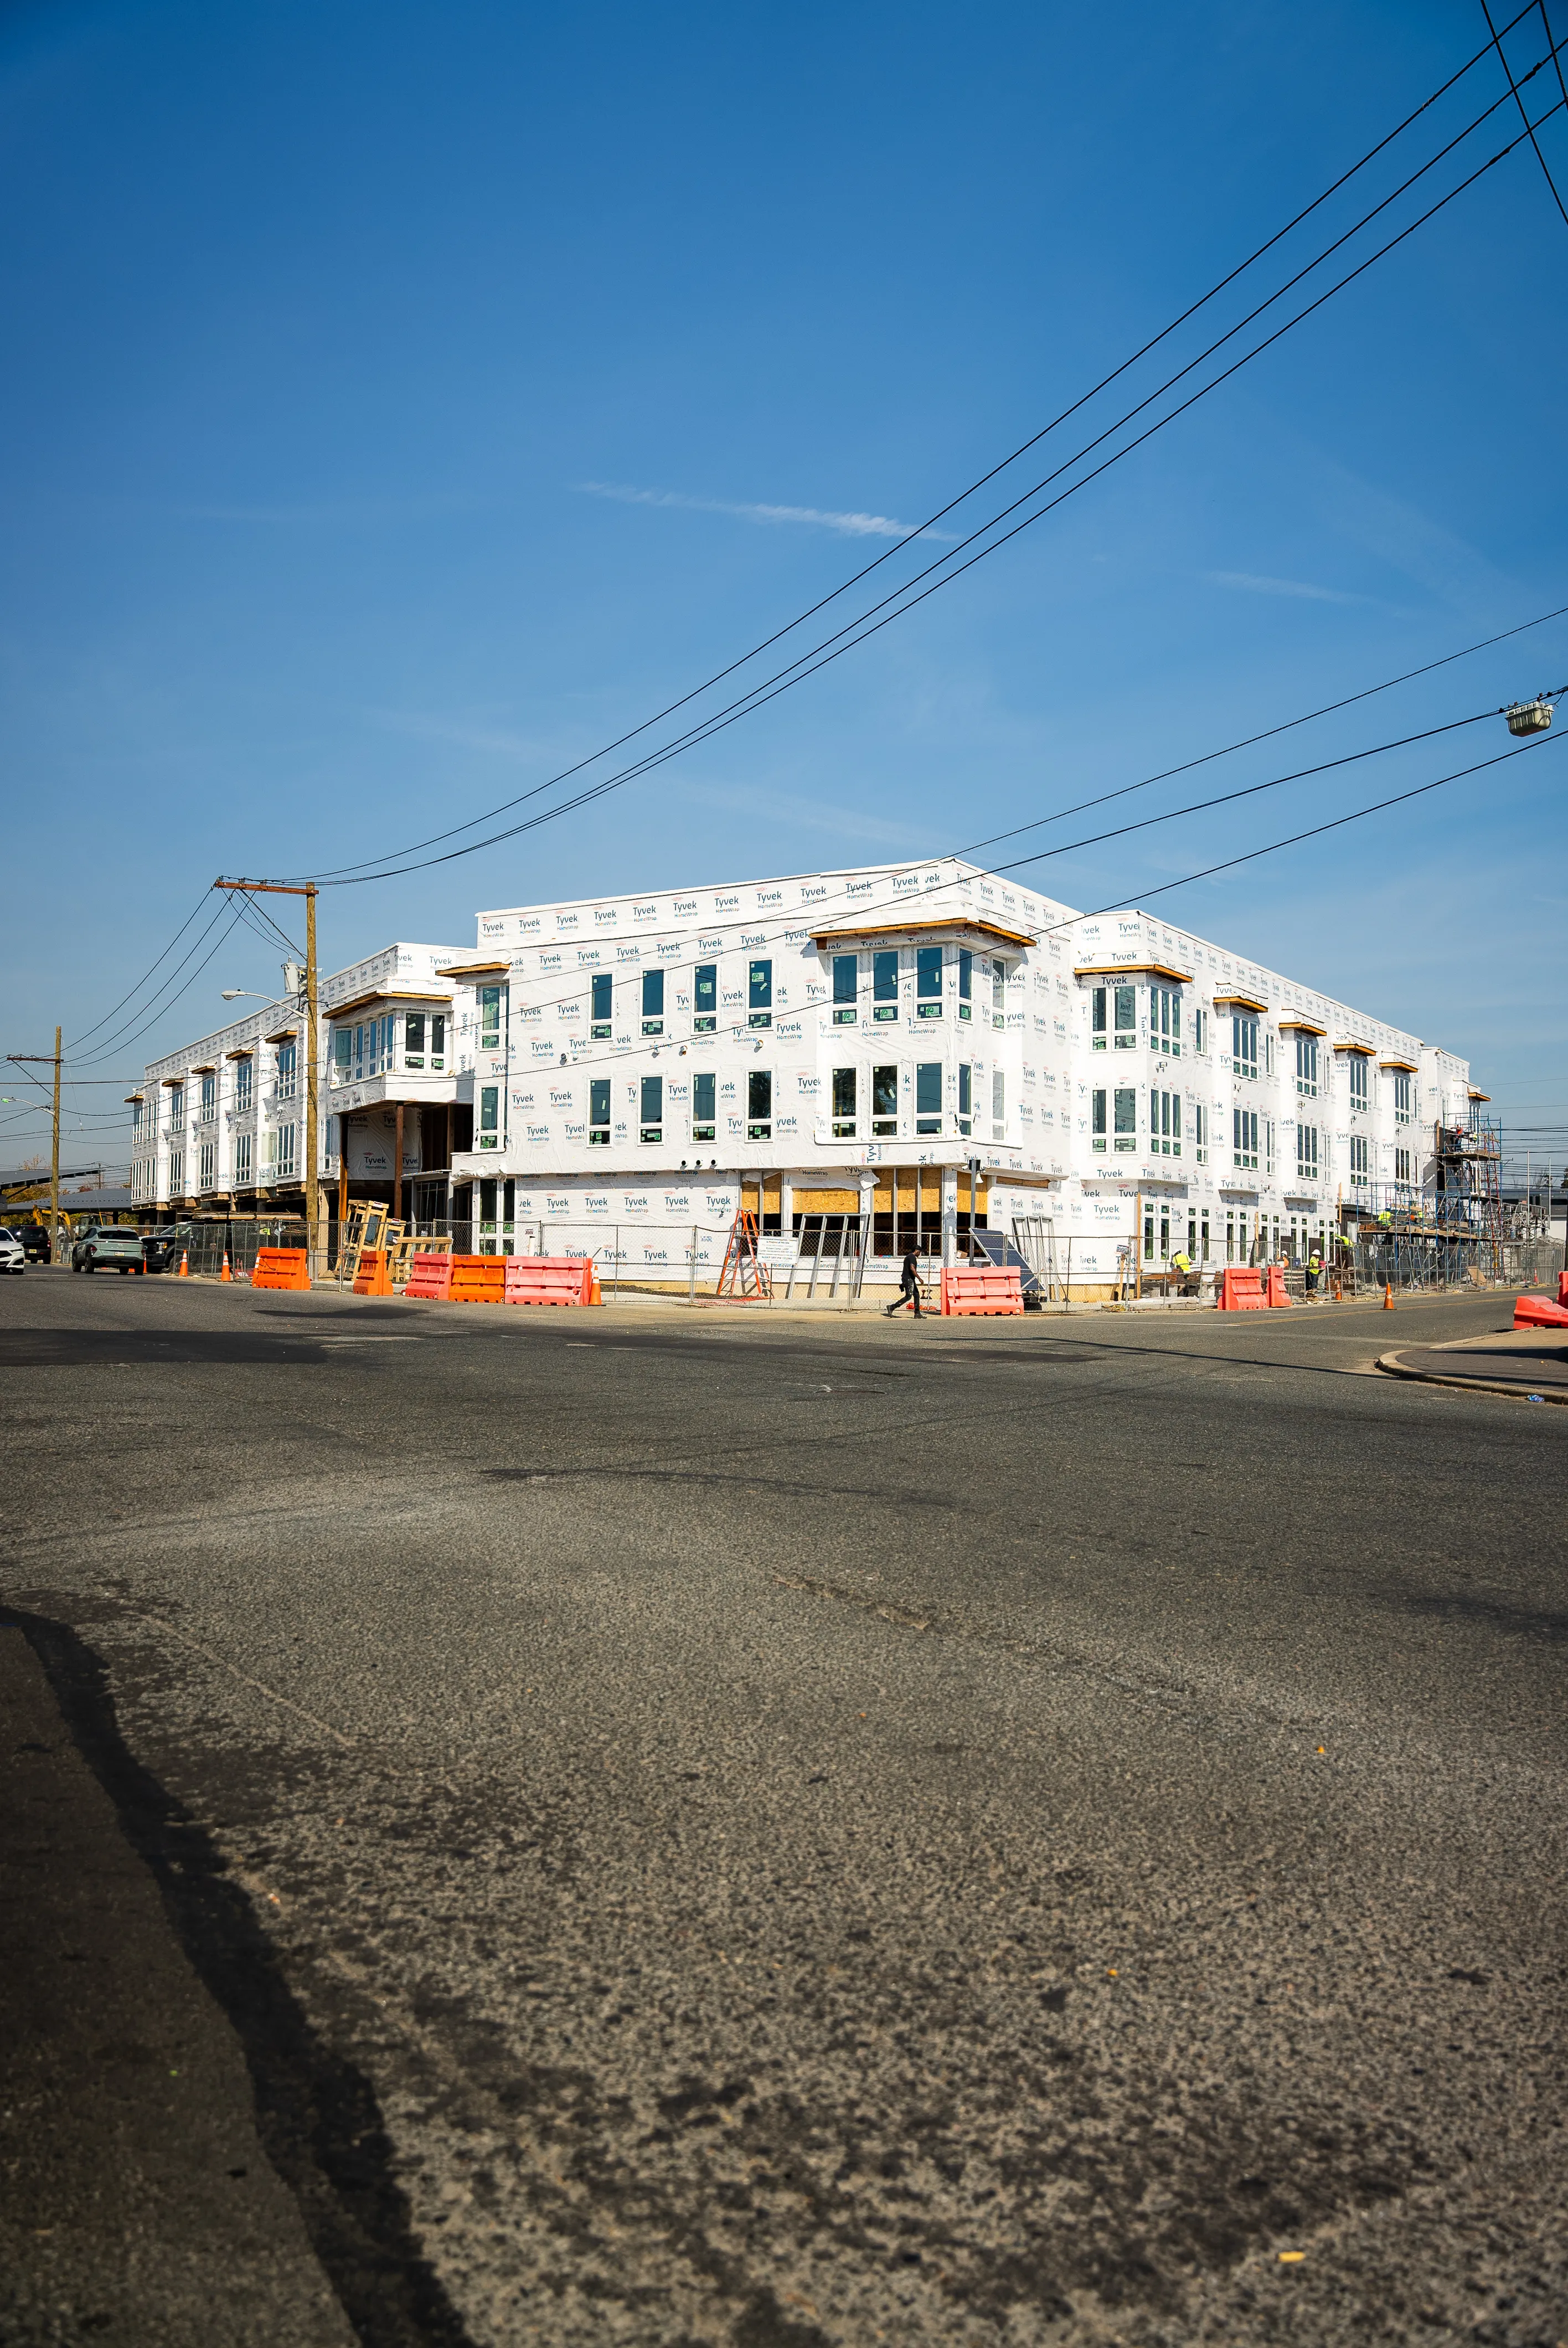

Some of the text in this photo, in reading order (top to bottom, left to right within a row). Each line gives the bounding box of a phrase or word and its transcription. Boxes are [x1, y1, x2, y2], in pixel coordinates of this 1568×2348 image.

[892, 876, 918, 888] Tyvek
[957, 873, 971, 886] Tyvek
[801, 887, 826, 898] Tyvek
[845, 881, 871, 893] Tyvek
[980, 883, 993, 895] Tyvek
[715, 896, 739, 908] Tyvek
[757, 891, 781, 903] Tyvek
[1002, 892, 1015, 904] Tyvek
[633, 905, 656, 916] Tyvek
[673, 901, 697, 912] Tyvek
[1023, 900, 1035, 913] Tyvek
[556, 914, 577, 925] Tyvek
[594, 910, 616, 921] Tyvek
[1043, 909, 1055, 920] Tyvek
[483, 922, 503, 933] Tyvek
[519, 918, 540, 929] Tyvek
[784, 930, 809, 941] Tyvek
[1147, 926, 1157, 937] Tyvek
[698, 939, 722, 950] Tyvek
[740, 934, 765, 945] Tyvek
[616, 946, 639, 957] Tyvek
[657, 943, 680, 953] Tyvek
[1049, 941, 1060, 952] Tyvek
[1178, 941, 1187, 951] Tyvek
[430, 956, 452, 965] Tyvek
[539, 954, 561, 965] Tyvek
[577, 950, 599, 961] Tyvek
[1036, 972, 1049, 984] Tyvek
[806, 985, 826, 995] Tyvek
[1056, 980, 1068, 991] Tyvek
[520, 1007, 541, 1017] Tyvek
[558, 1004, 579, 1015] Tyvek
[1034, 1015, 1046, 1027] Tyvek
[1054, 1021, 1065, 1032] Tyvek
[776, 1022, 801, 1034] Tyvek
[532, 1042, 553, 1052] Tyvek
[1023, 1067, 1035, 1078] Tyvek
[1044, 1072, 1055, 1083] Tyvek
[798, 1077, 821, 1088] Tyvek
[512, 1094, 534, 1105] Tyvek
[550, 1091, 571, 1102] Tyvek
[1019, 1105, 1033, 1116] Tyvek
[1041, 1109, 1053, 1120] Tyvek
[527, 1126, 548, 1136] Tyvek
[987, 1156, 1000, 1167] Tyvek
[1010, 1159, 1022, 1170] Tyvek
[1031, 1162, 1043, 1171] Tyvek
[1051, 1164, 1062, 1174] Tyvek
[1097, 1170, 1122, 1179] Tyvek
[1142, 1169, 1156, 1178] Tyvek
[547, 1198, 569, 1208] Tyvek
[585, 1198, 607, 1207] Tyvek
[625, 1197, 647, 1207] Tyvek
[664, 1197, 688, 1207] Tyvek
[706, 1196, 730, 1207] Tyvek
[1011, 1198, 1023, 1208] Tyvek
[1032, 1201, 1044, 1211] Tyvek
[1052, 1202, 1063, 1212] Tyvek
[1094, 1205, 1119, 1214] Tyvek
[604, 1250, 627, 1260] Tyvek
[644, 1250, 667, 1260] Tyvek
